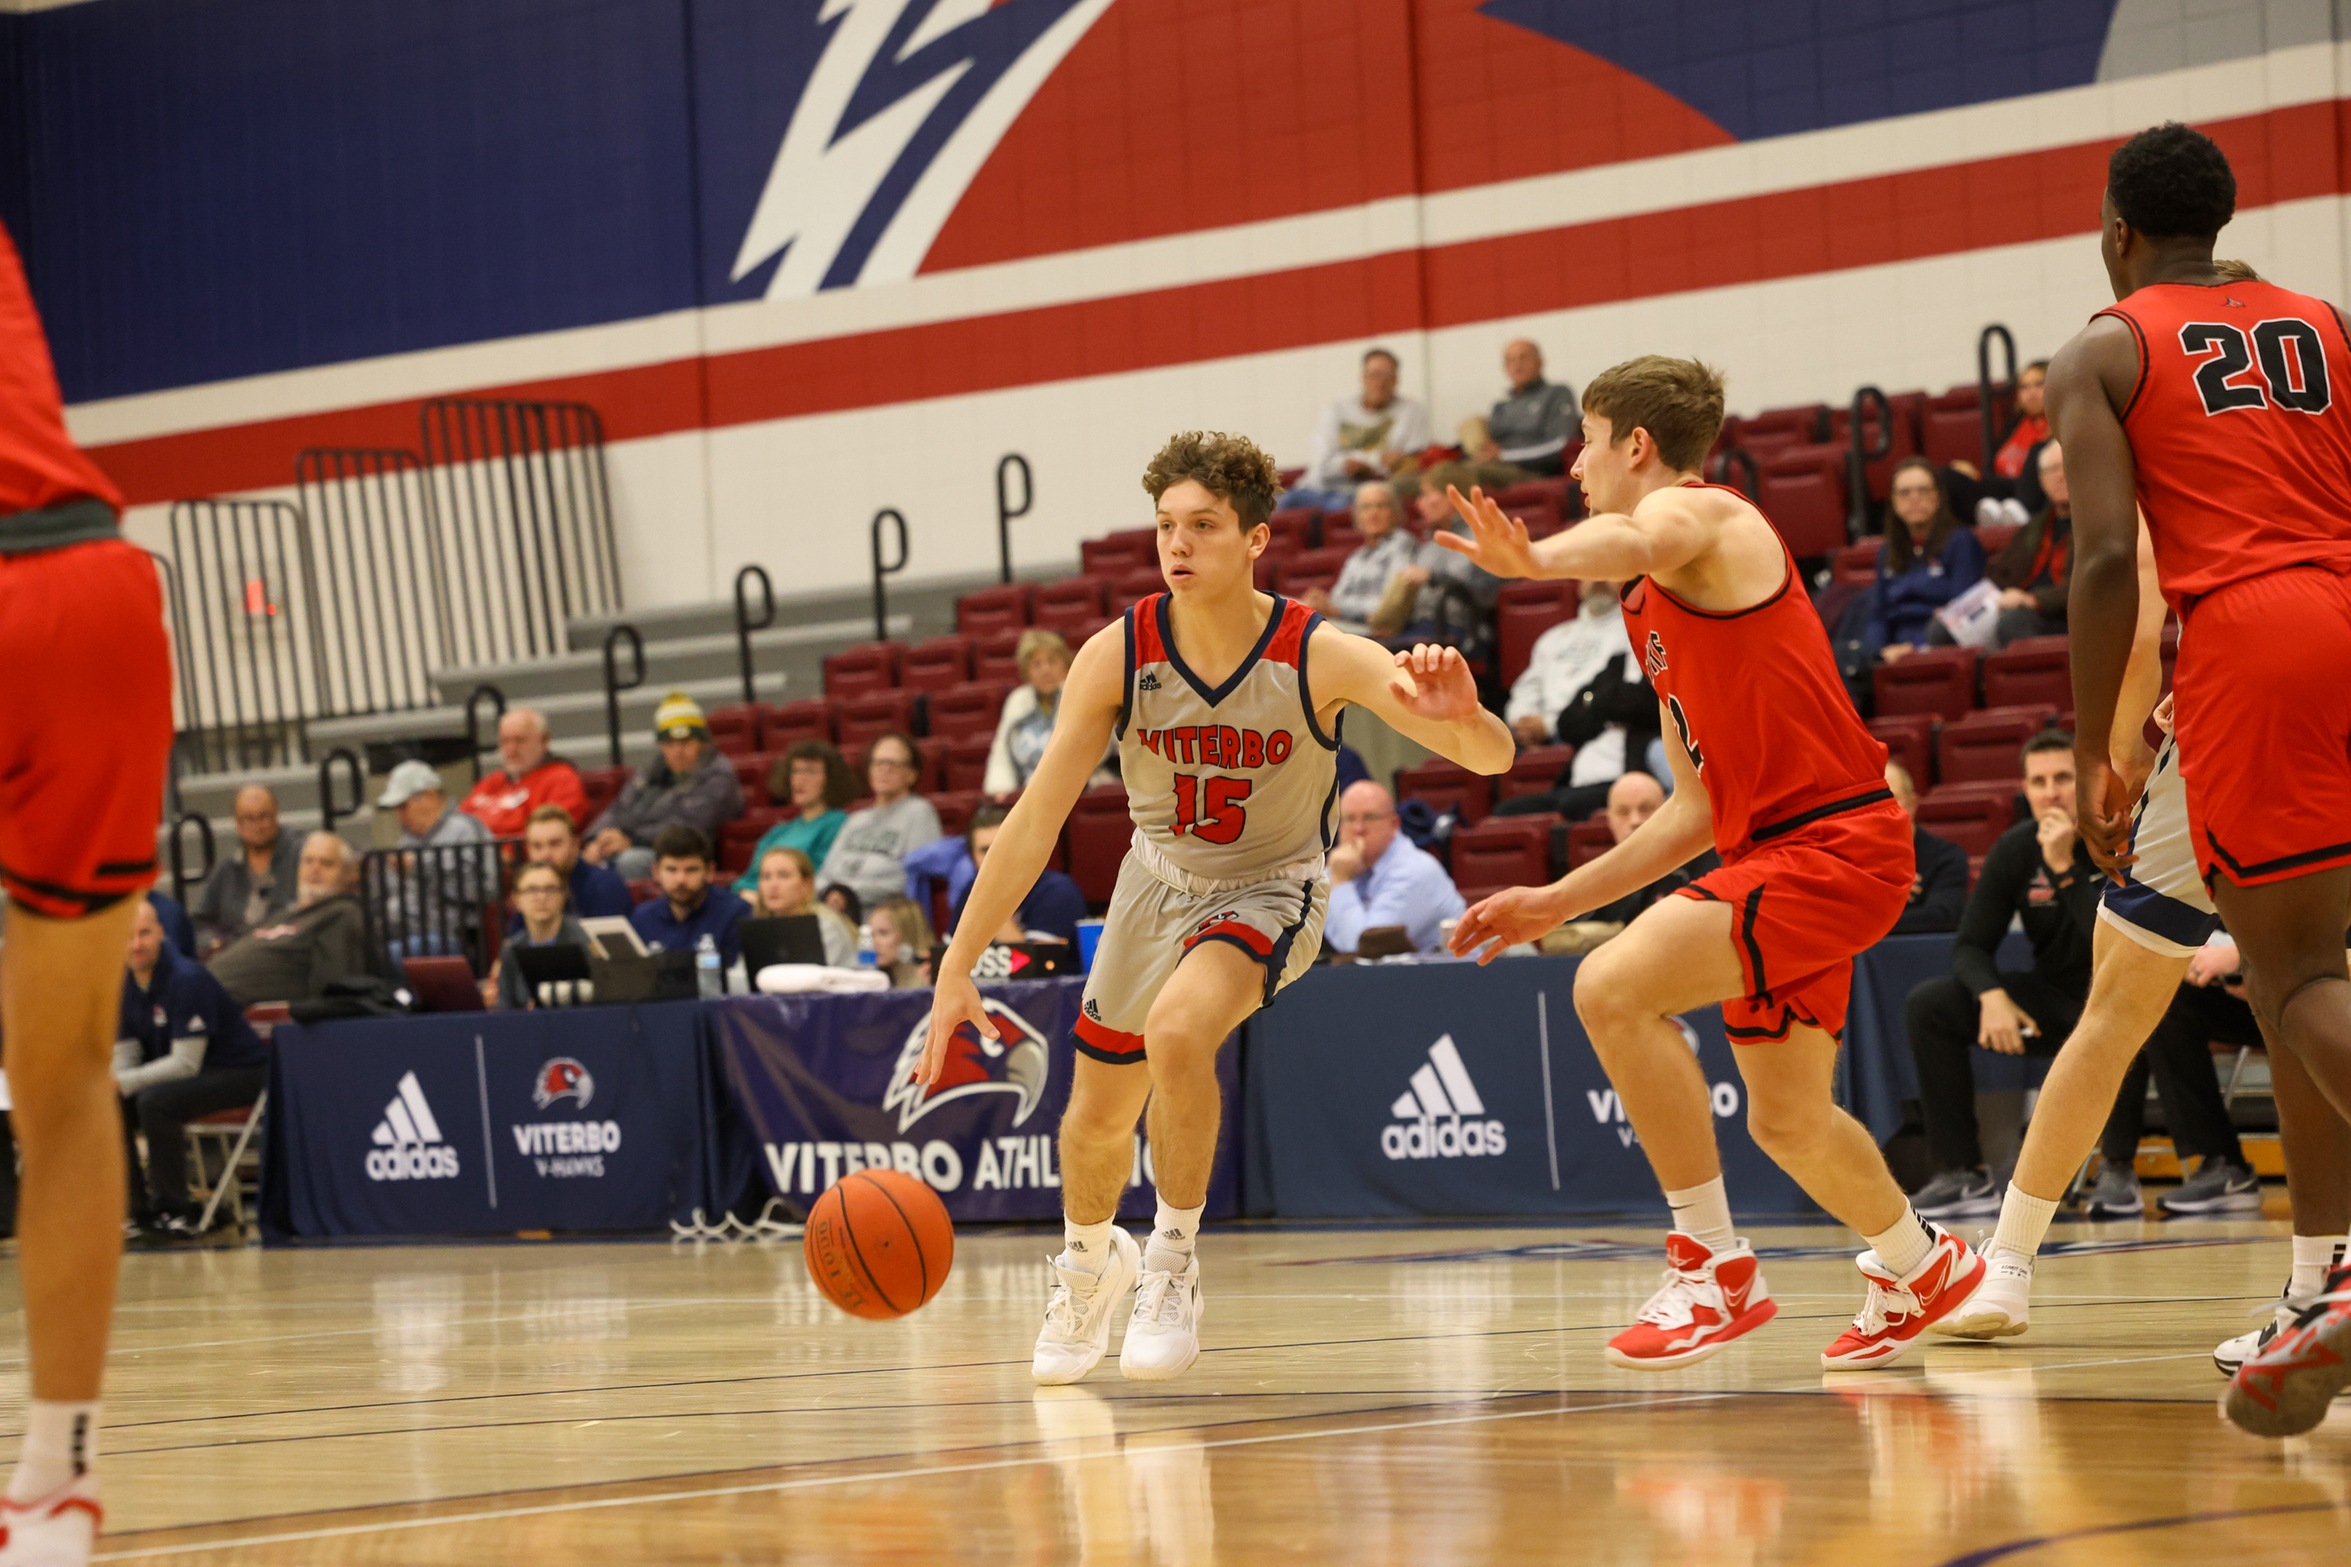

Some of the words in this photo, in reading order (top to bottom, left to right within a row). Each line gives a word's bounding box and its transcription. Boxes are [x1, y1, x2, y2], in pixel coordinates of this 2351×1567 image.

[2178, 318, 2332, 416] 20
[1137, 725, 1293, 769] VITERBO
[1168, 772, 1252, 844] 15
[512, 1120, 621, 1155] VITERBO
[1381, 1114, 1507, 1160] adidas
[365, 1142, 460, 1181] adidas
